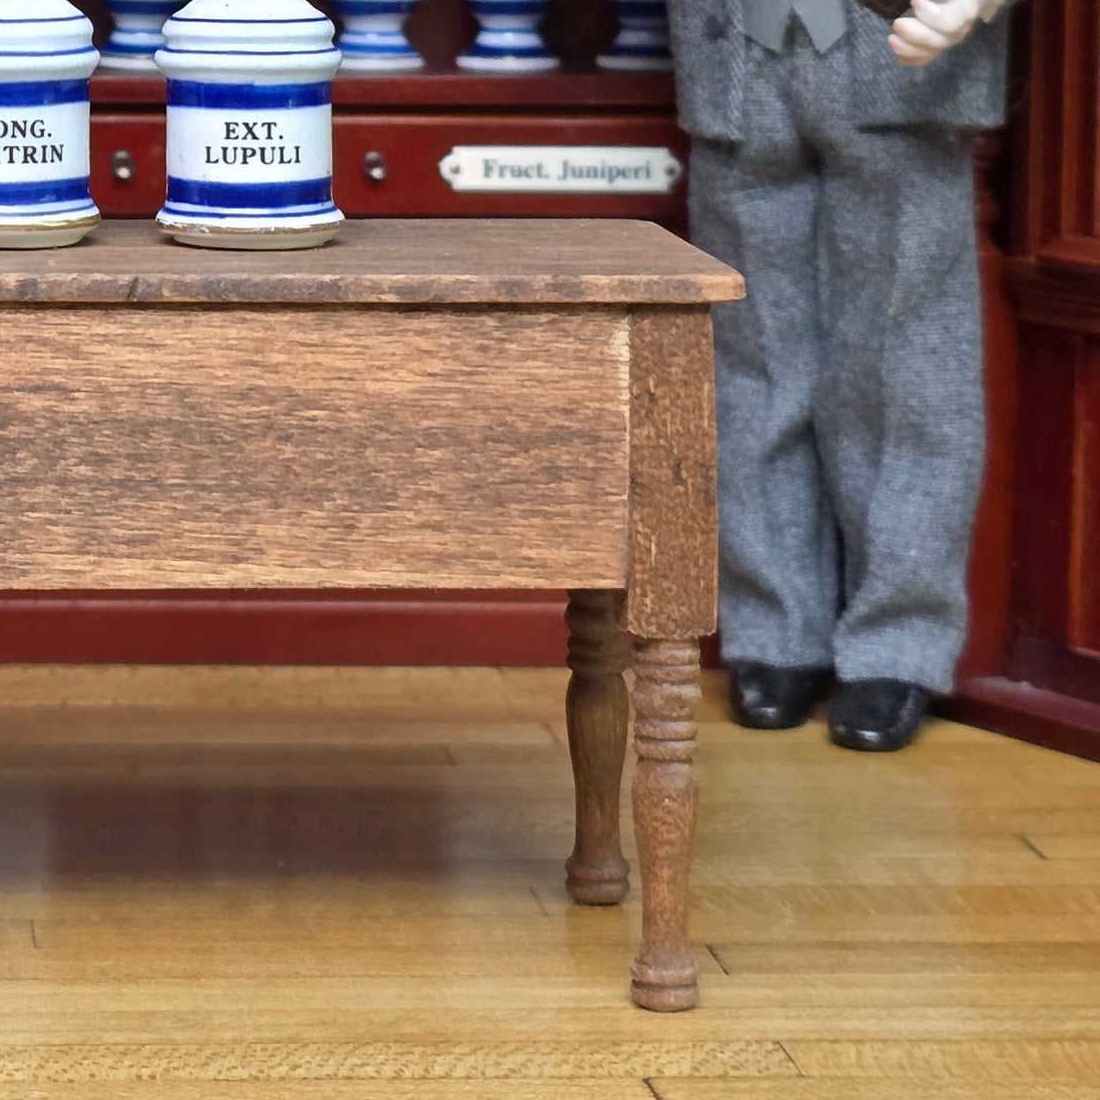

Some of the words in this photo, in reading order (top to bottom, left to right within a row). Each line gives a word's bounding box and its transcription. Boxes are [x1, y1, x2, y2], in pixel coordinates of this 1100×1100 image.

[224, 121, 285, 141] EXT.
[204, 145, 301, 165] LUPULI
[482, 158, 551, 180] Fruct.
[556, 158, 652, 184] Juniperi
